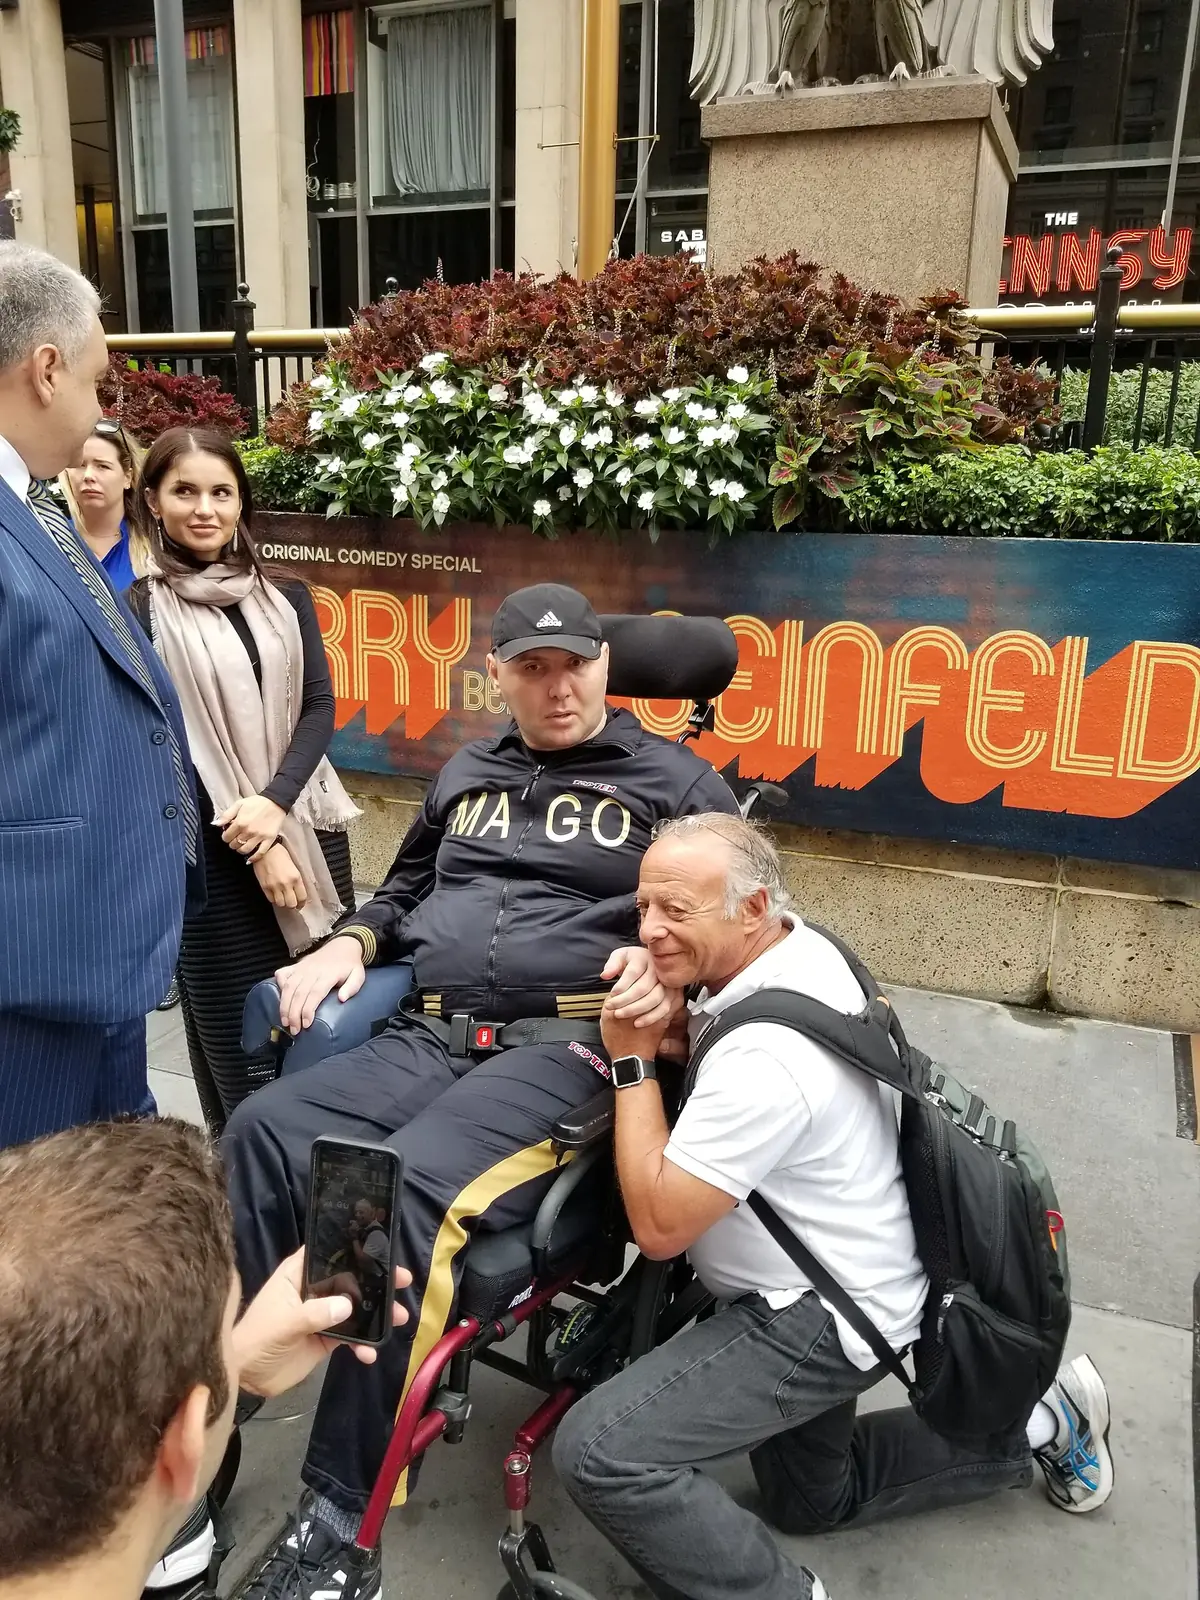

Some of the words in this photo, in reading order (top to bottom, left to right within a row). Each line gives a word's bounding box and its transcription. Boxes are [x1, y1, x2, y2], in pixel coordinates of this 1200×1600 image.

[1044, 212, 1079, 226] THE
[261, 543, 335, 563] ORIGINAL
[337, 548, 408, 568] COMEDY
[411, 553, 482, 573] SPECIAL
[536, 619, 563, 628] adidas
